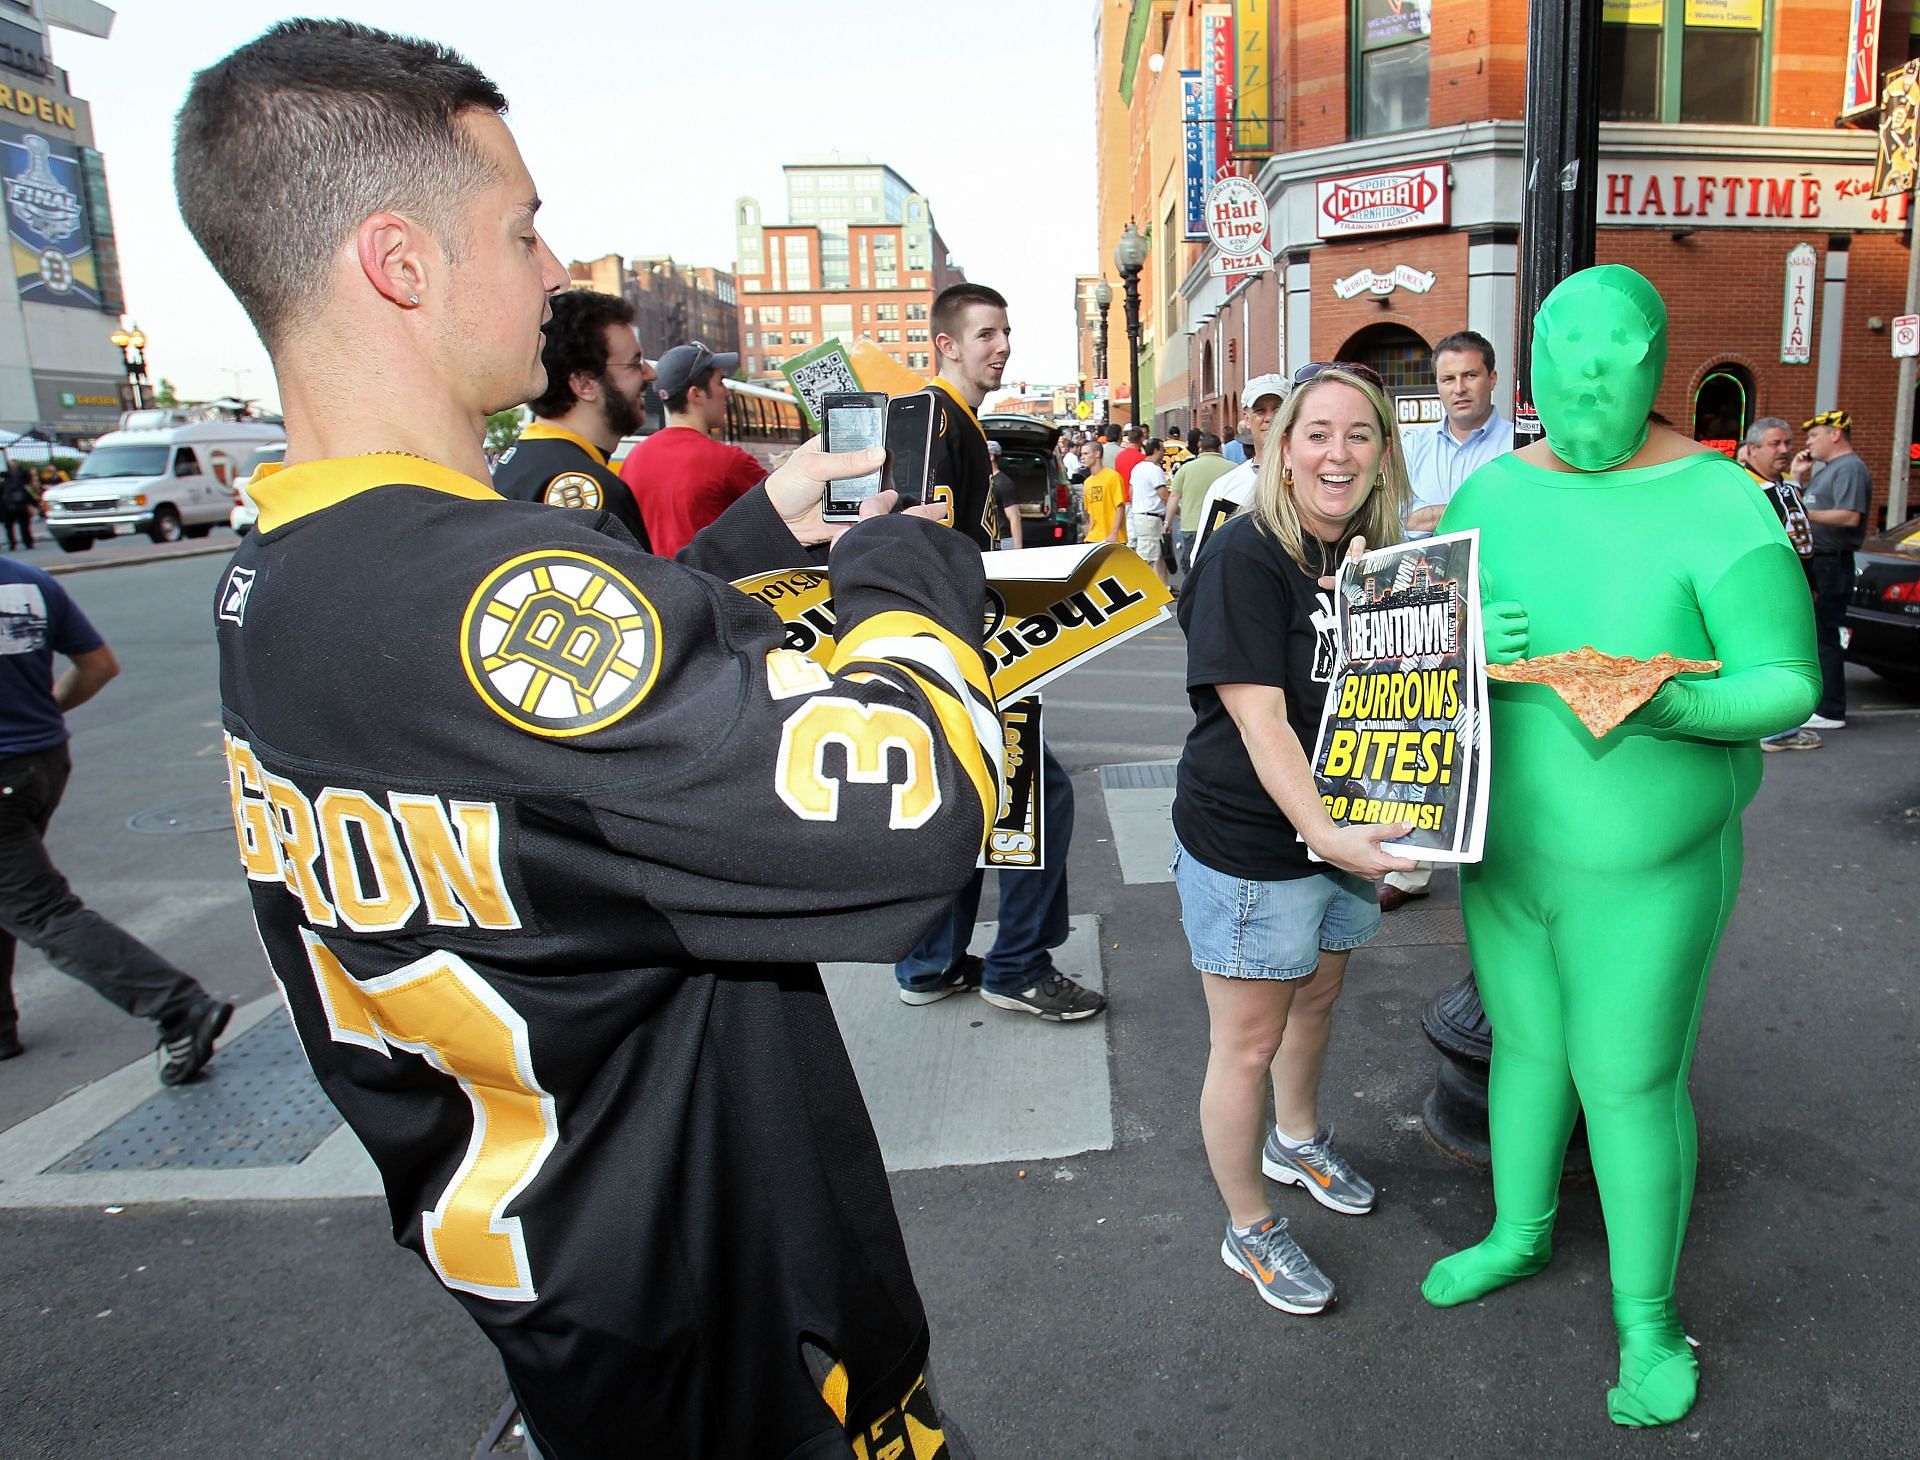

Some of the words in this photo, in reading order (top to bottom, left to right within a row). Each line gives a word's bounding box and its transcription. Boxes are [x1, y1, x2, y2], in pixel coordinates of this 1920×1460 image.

[1215, 16, 1226, 86] DANCE
[12, 183, 77, 209] FINAL
[1188, 177, 1197, 221] HILL
[1337, 180, 1420, 214] COMBAT
[1360, 178, 1398, 190] SPORTS
[1605, 174, 1821, 218] HALFTIME
[1835, 178, 1876, 200] Kin
[1215, 200, 1258, 220] Half
[1340, 222, 1380, 231] TRAINING
[1382, 214, 1420, 229] FACILITY
[1872, 198, 1889, 223] of
[1213, 220, 1263, 239] Time
[1221, 253, 1265, 271] PIZZA
[1345, 274, 1370, 294] WORLD
[1372, 278, 1393, 290] PIZZA
[1791, 275, 1806, 346] ITALIAN
[1399, 399, 1419, 422] GO
[1420, 399, 1446, 422] BR
[1448, 583, 1457, 613] DRINK
[1350, 602, 1449, 660] BEANTOWN
[1448, 616, 1457, 653] ENERGY
[1337, 668, 1459, 720] BURROWS
[1322, 729, 1456, 785] BITES!
[1321, 795, 1348, 820] GO
[1348, 797, 1445, 831] BRUINS!
